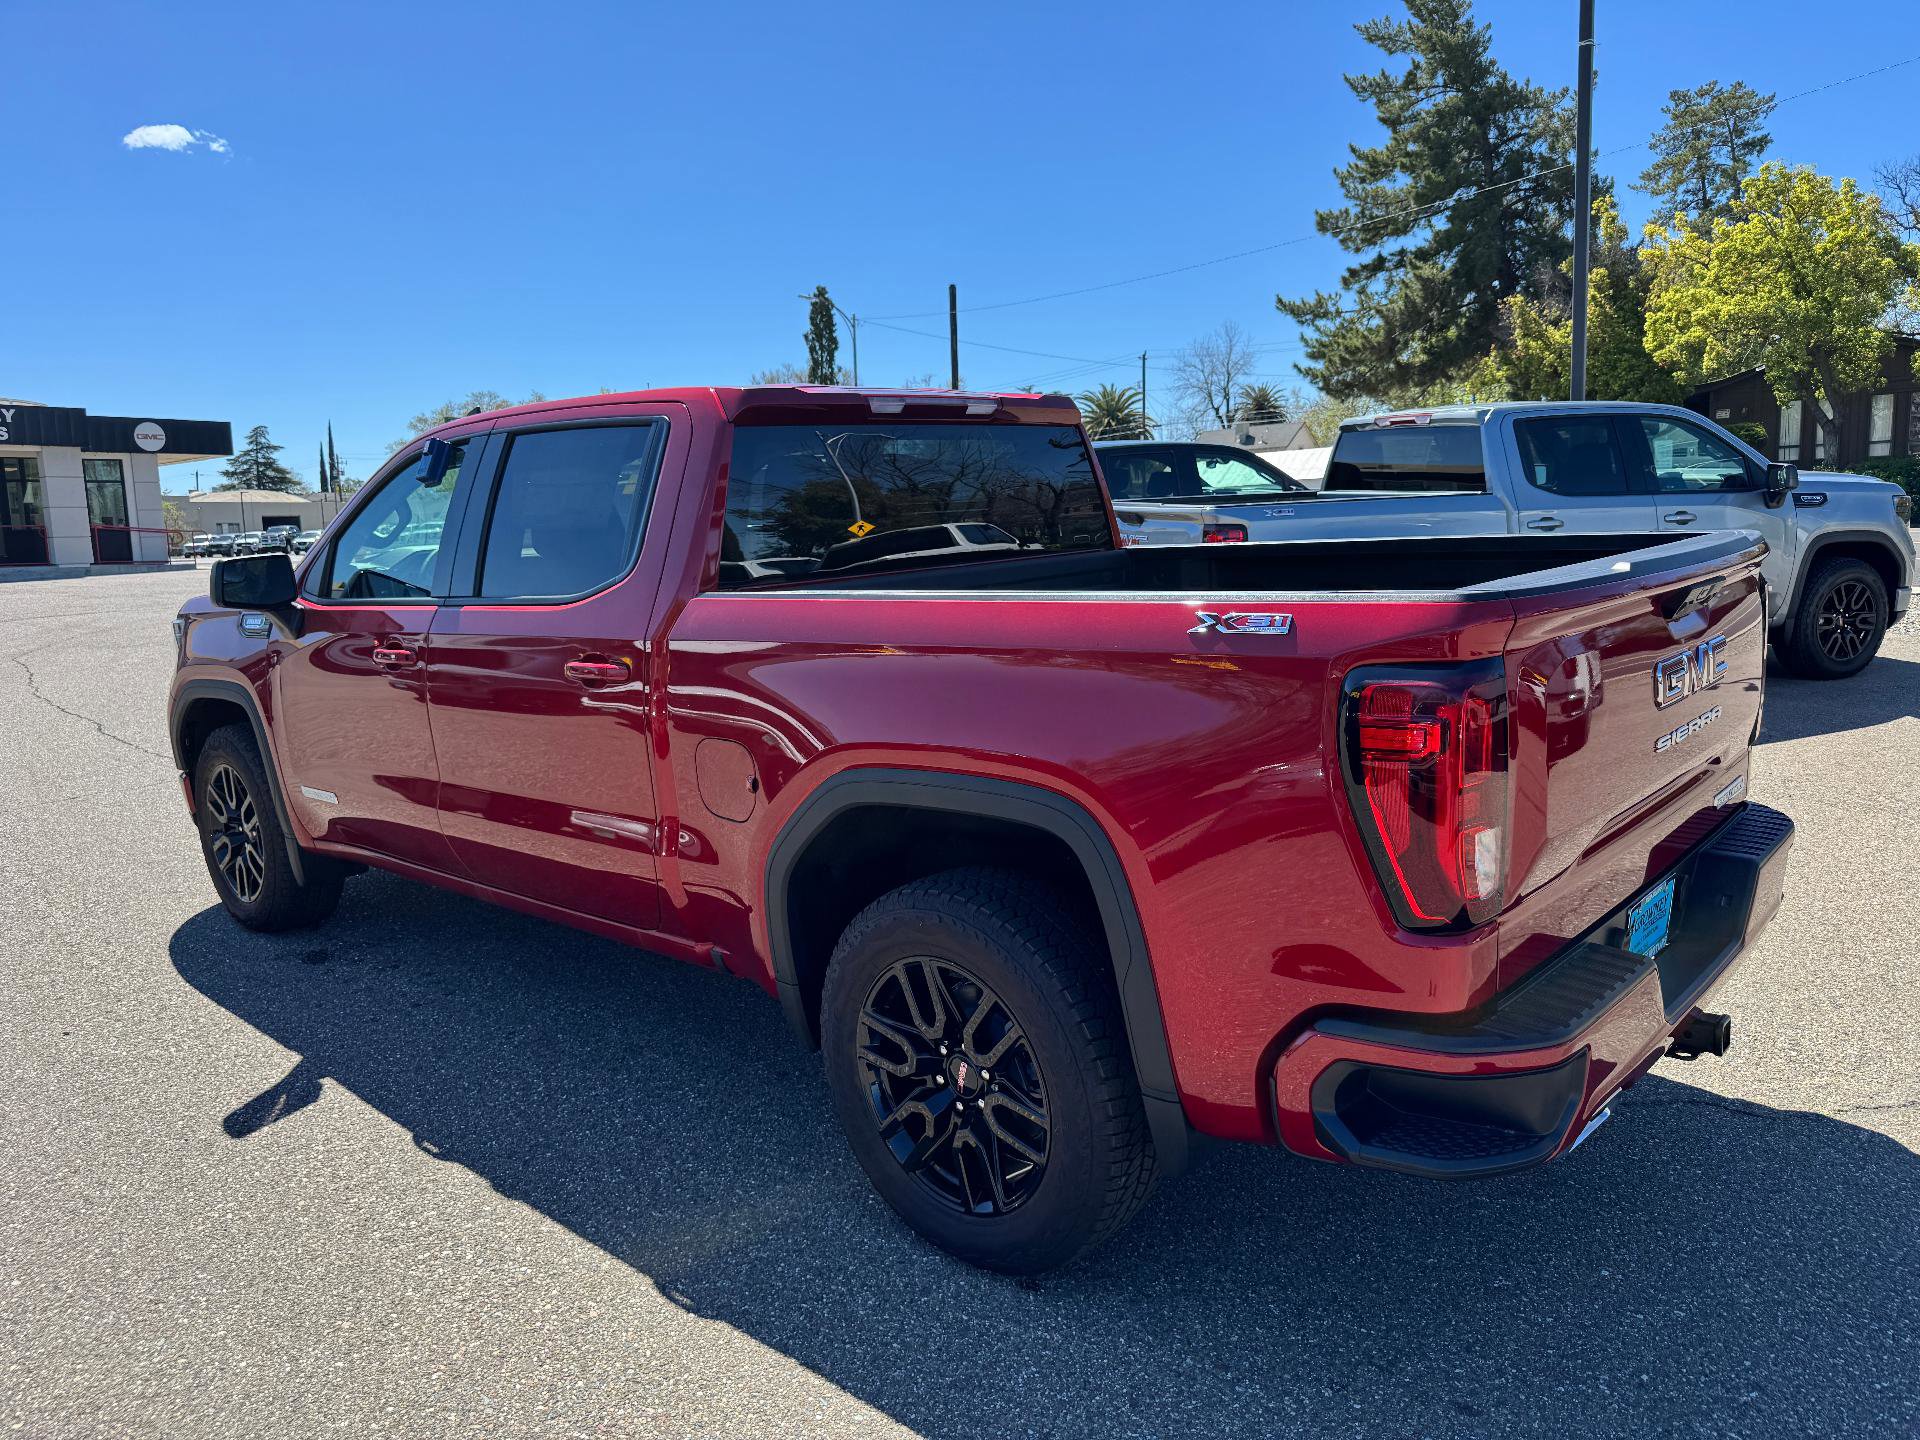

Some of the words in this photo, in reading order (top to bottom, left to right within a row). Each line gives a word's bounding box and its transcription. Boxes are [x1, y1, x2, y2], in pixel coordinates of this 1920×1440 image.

[0, 408, 16, 423] Y
[1652, 633, 1729, 711] GMC
[1653, 705, 1722, 753] SIERRA
